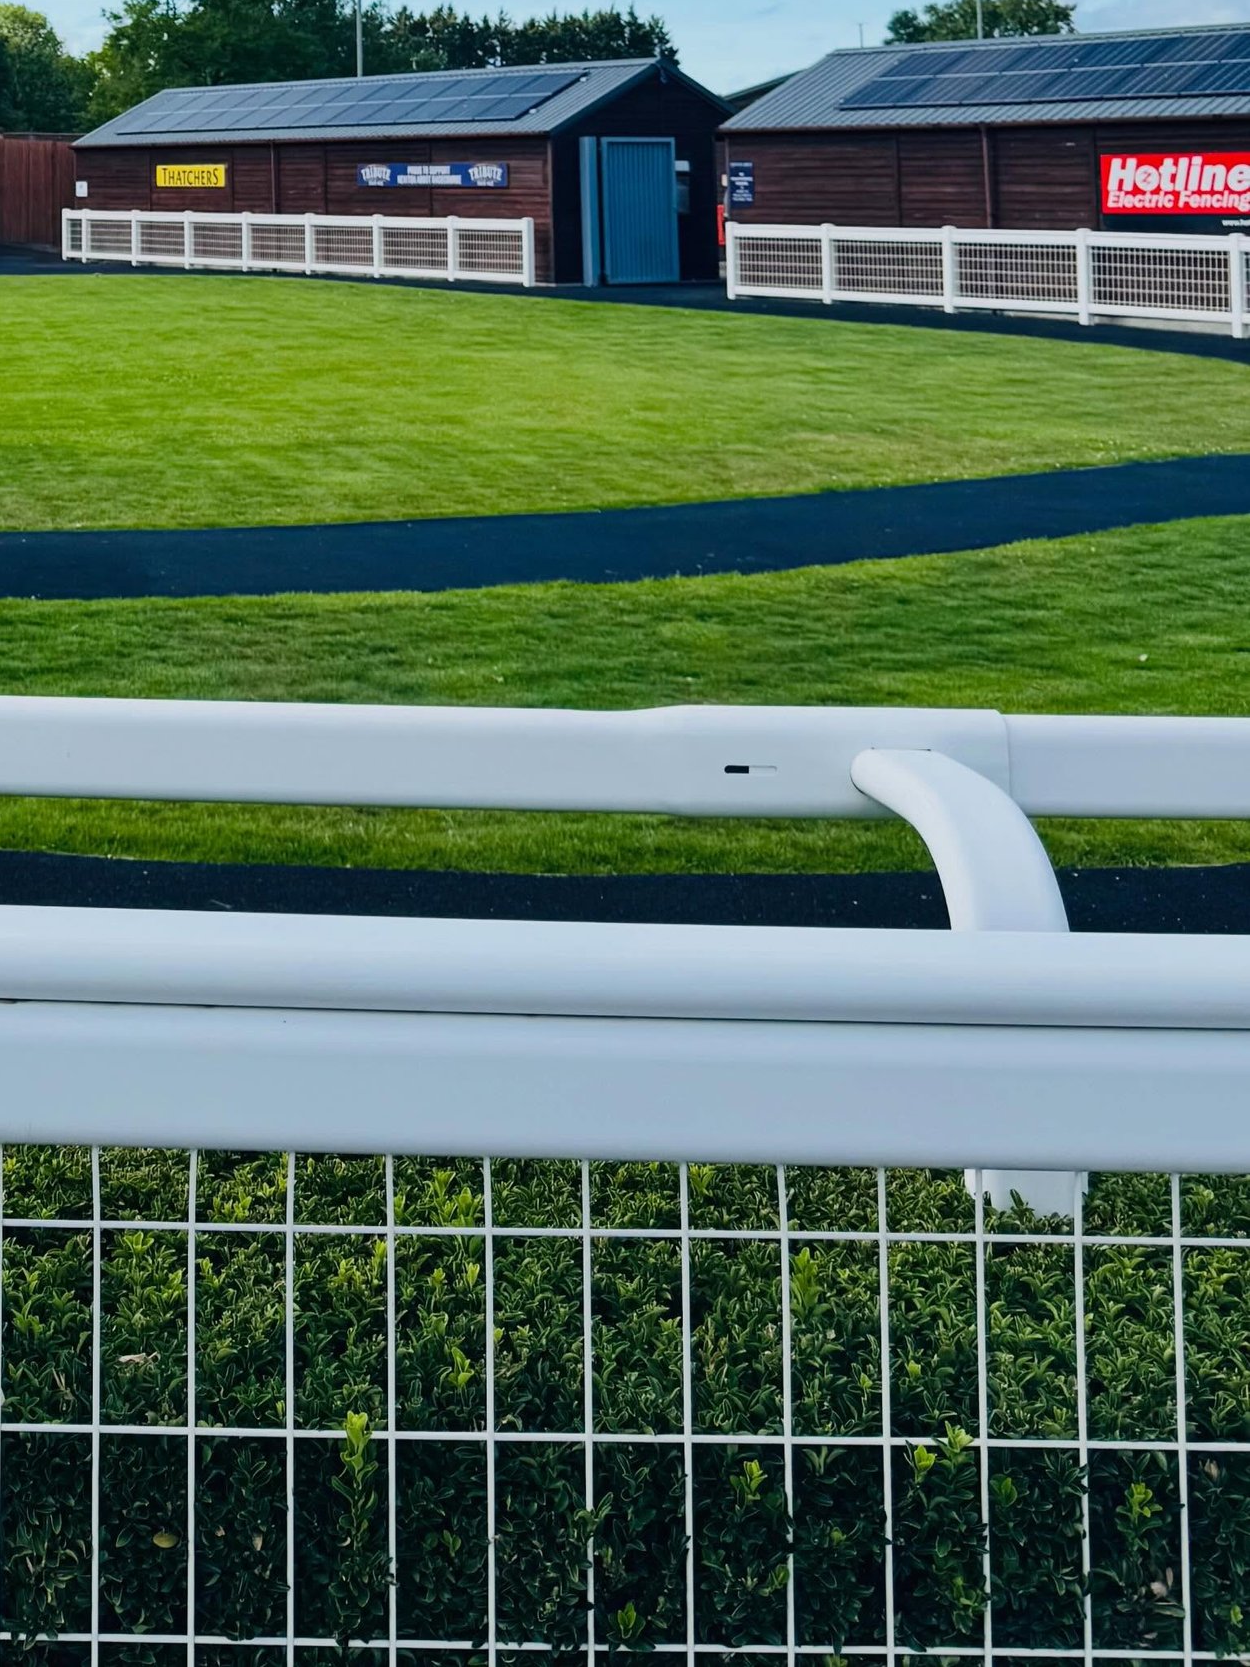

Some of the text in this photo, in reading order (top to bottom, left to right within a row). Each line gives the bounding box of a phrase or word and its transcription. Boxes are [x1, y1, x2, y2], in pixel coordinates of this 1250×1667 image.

[162, 167, 219, 186] THATCHERS
[1107, 156, 1250, 192] Hotline
[1107, 190, 1250, 212] Electric Fencing
